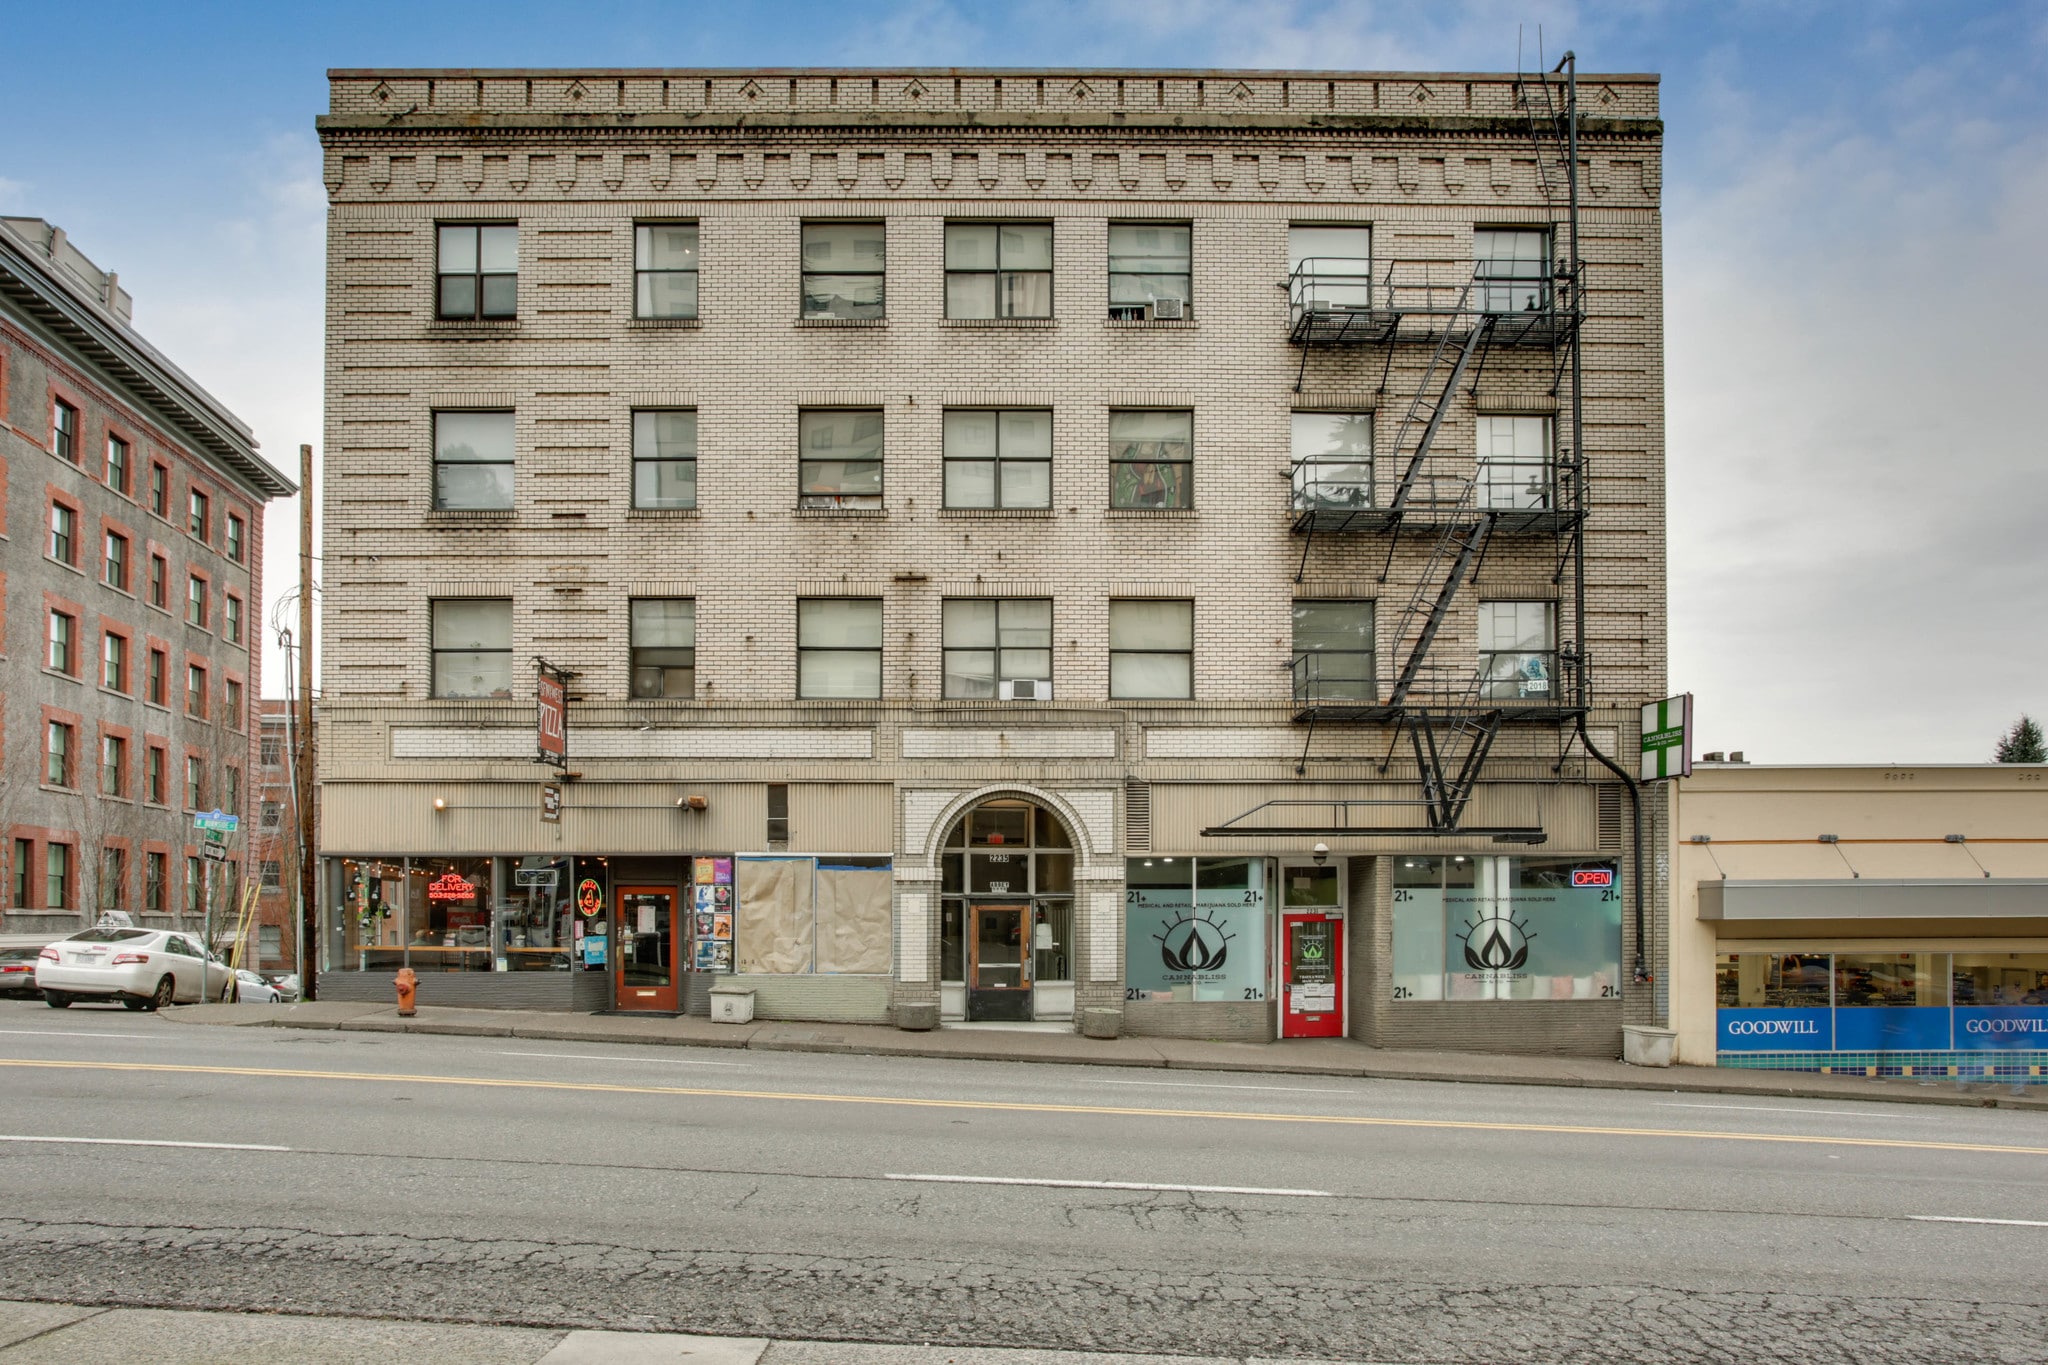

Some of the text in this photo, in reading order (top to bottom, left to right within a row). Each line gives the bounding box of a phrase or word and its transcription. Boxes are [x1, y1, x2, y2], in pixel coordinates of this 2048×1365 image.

[1529, 681, 1547, 690] 2018
[540, 703, 563, 740] PIZZA
[1643, 730, 1682, 744] CANNABLISS
[990, 854, 1009, 862] 2235
[441, 874, 462, 883] FOR
[518, 872, 552, 883] OPEN
[1574, 872, 1609, 884] OPEN
[429, 882, 475, 891] DELIVERY
[582, 880, 597, 891] PIZZA
[1127, 891, 1147, 903] 21+
[1244, 890, 1263, 903] 21+
[1394, 890, 1413, 902] 21+
[1601, 890, 1620, 902] 21+
[1162, 973, 1227, 981] CANNABLISS
[1126, 988, 1146, 1000] 21+
[1244, 988, 1263, 1000] 21+
[1393, 987, 1413, 999] 21+
[1601, 986, 1620, 998] 21+
[1728, 1019, 1819, 1035] GOODWILL
[1965, 1018, 2048, 1033] GOODWIL
